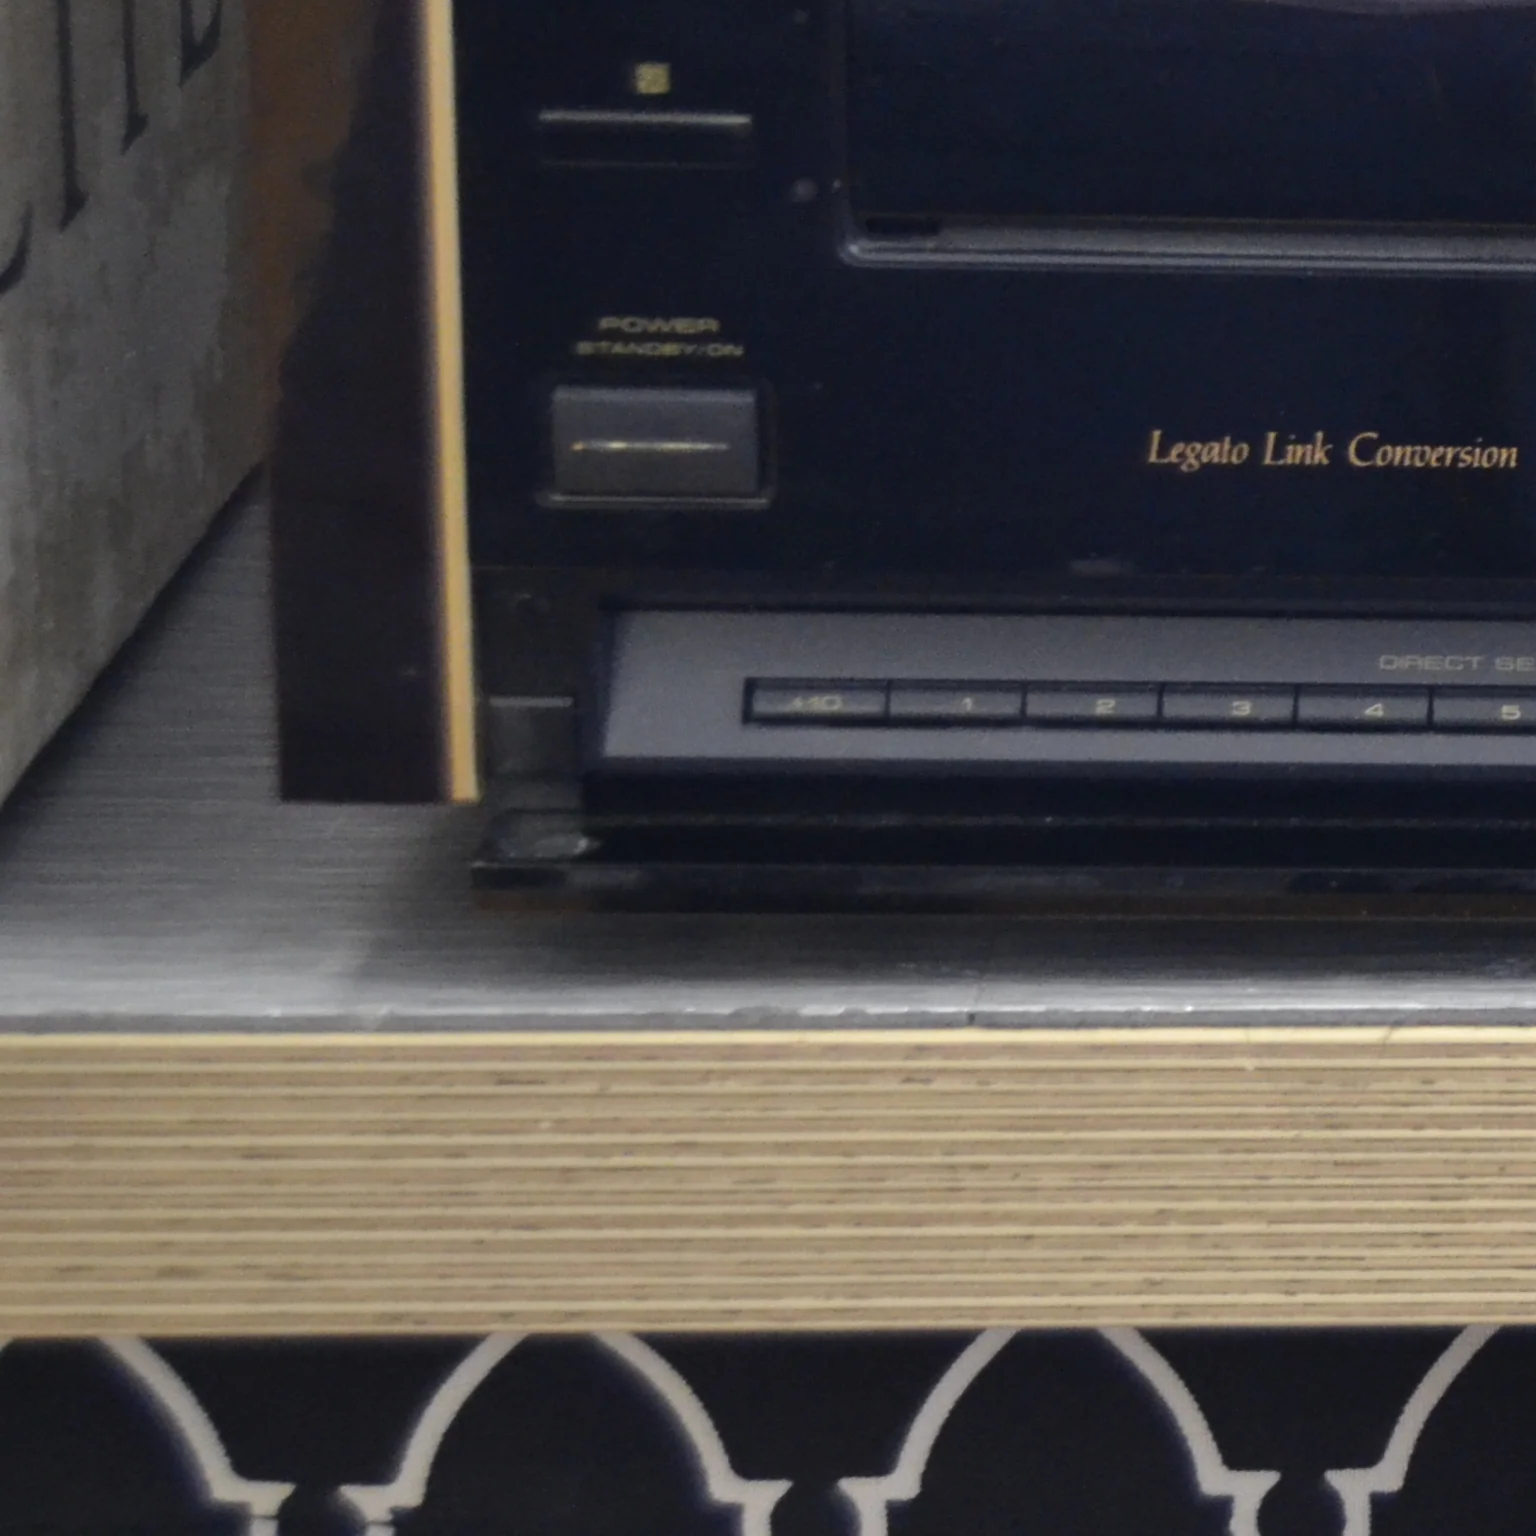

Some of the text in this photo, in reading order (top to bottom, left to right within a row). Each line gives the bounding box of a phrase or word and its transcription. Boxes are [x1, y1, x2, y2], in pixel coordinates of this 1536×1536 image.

[598, 316, 721, 334] POWER
[1147, 429, 1520, 475] Legato Link Conversion
[1378, 654, 1484, 671] DIRECT
[959, 697, 974, 712] 1
[1095, 699, 1117, 716] 2
[1230, 701, 1252, 717] 3
[1363, 703, 1385, 718] 4
[1500, 705, 1522, 720] 5
